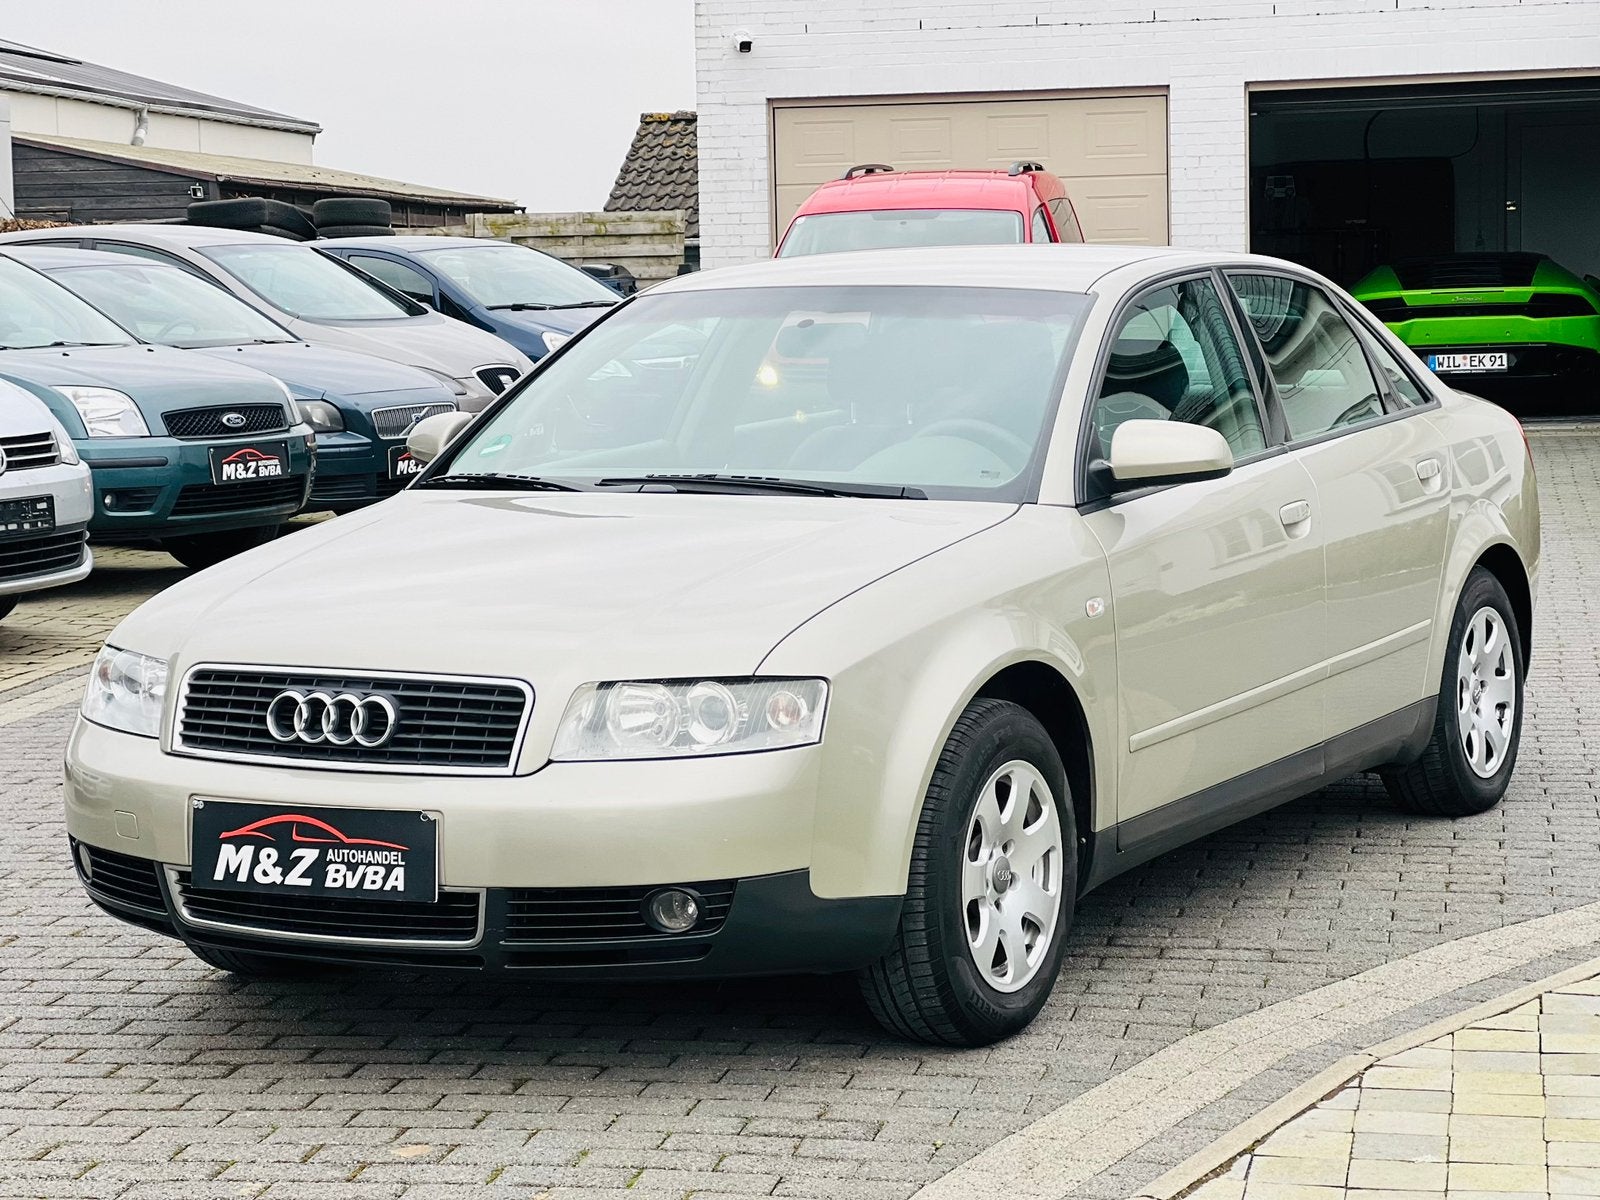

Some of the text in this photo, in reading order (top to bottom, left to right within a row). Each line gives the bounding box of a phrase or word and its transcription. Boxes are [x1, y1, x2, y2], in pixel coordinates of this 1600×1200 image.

[1437, 355, 1505, 368] WIL EK 91
[222, 461, 257, 480] M&Z
[213, 843, 320, 887] M&Z
[326, 848, 406, 866] AUTOHANDEL
